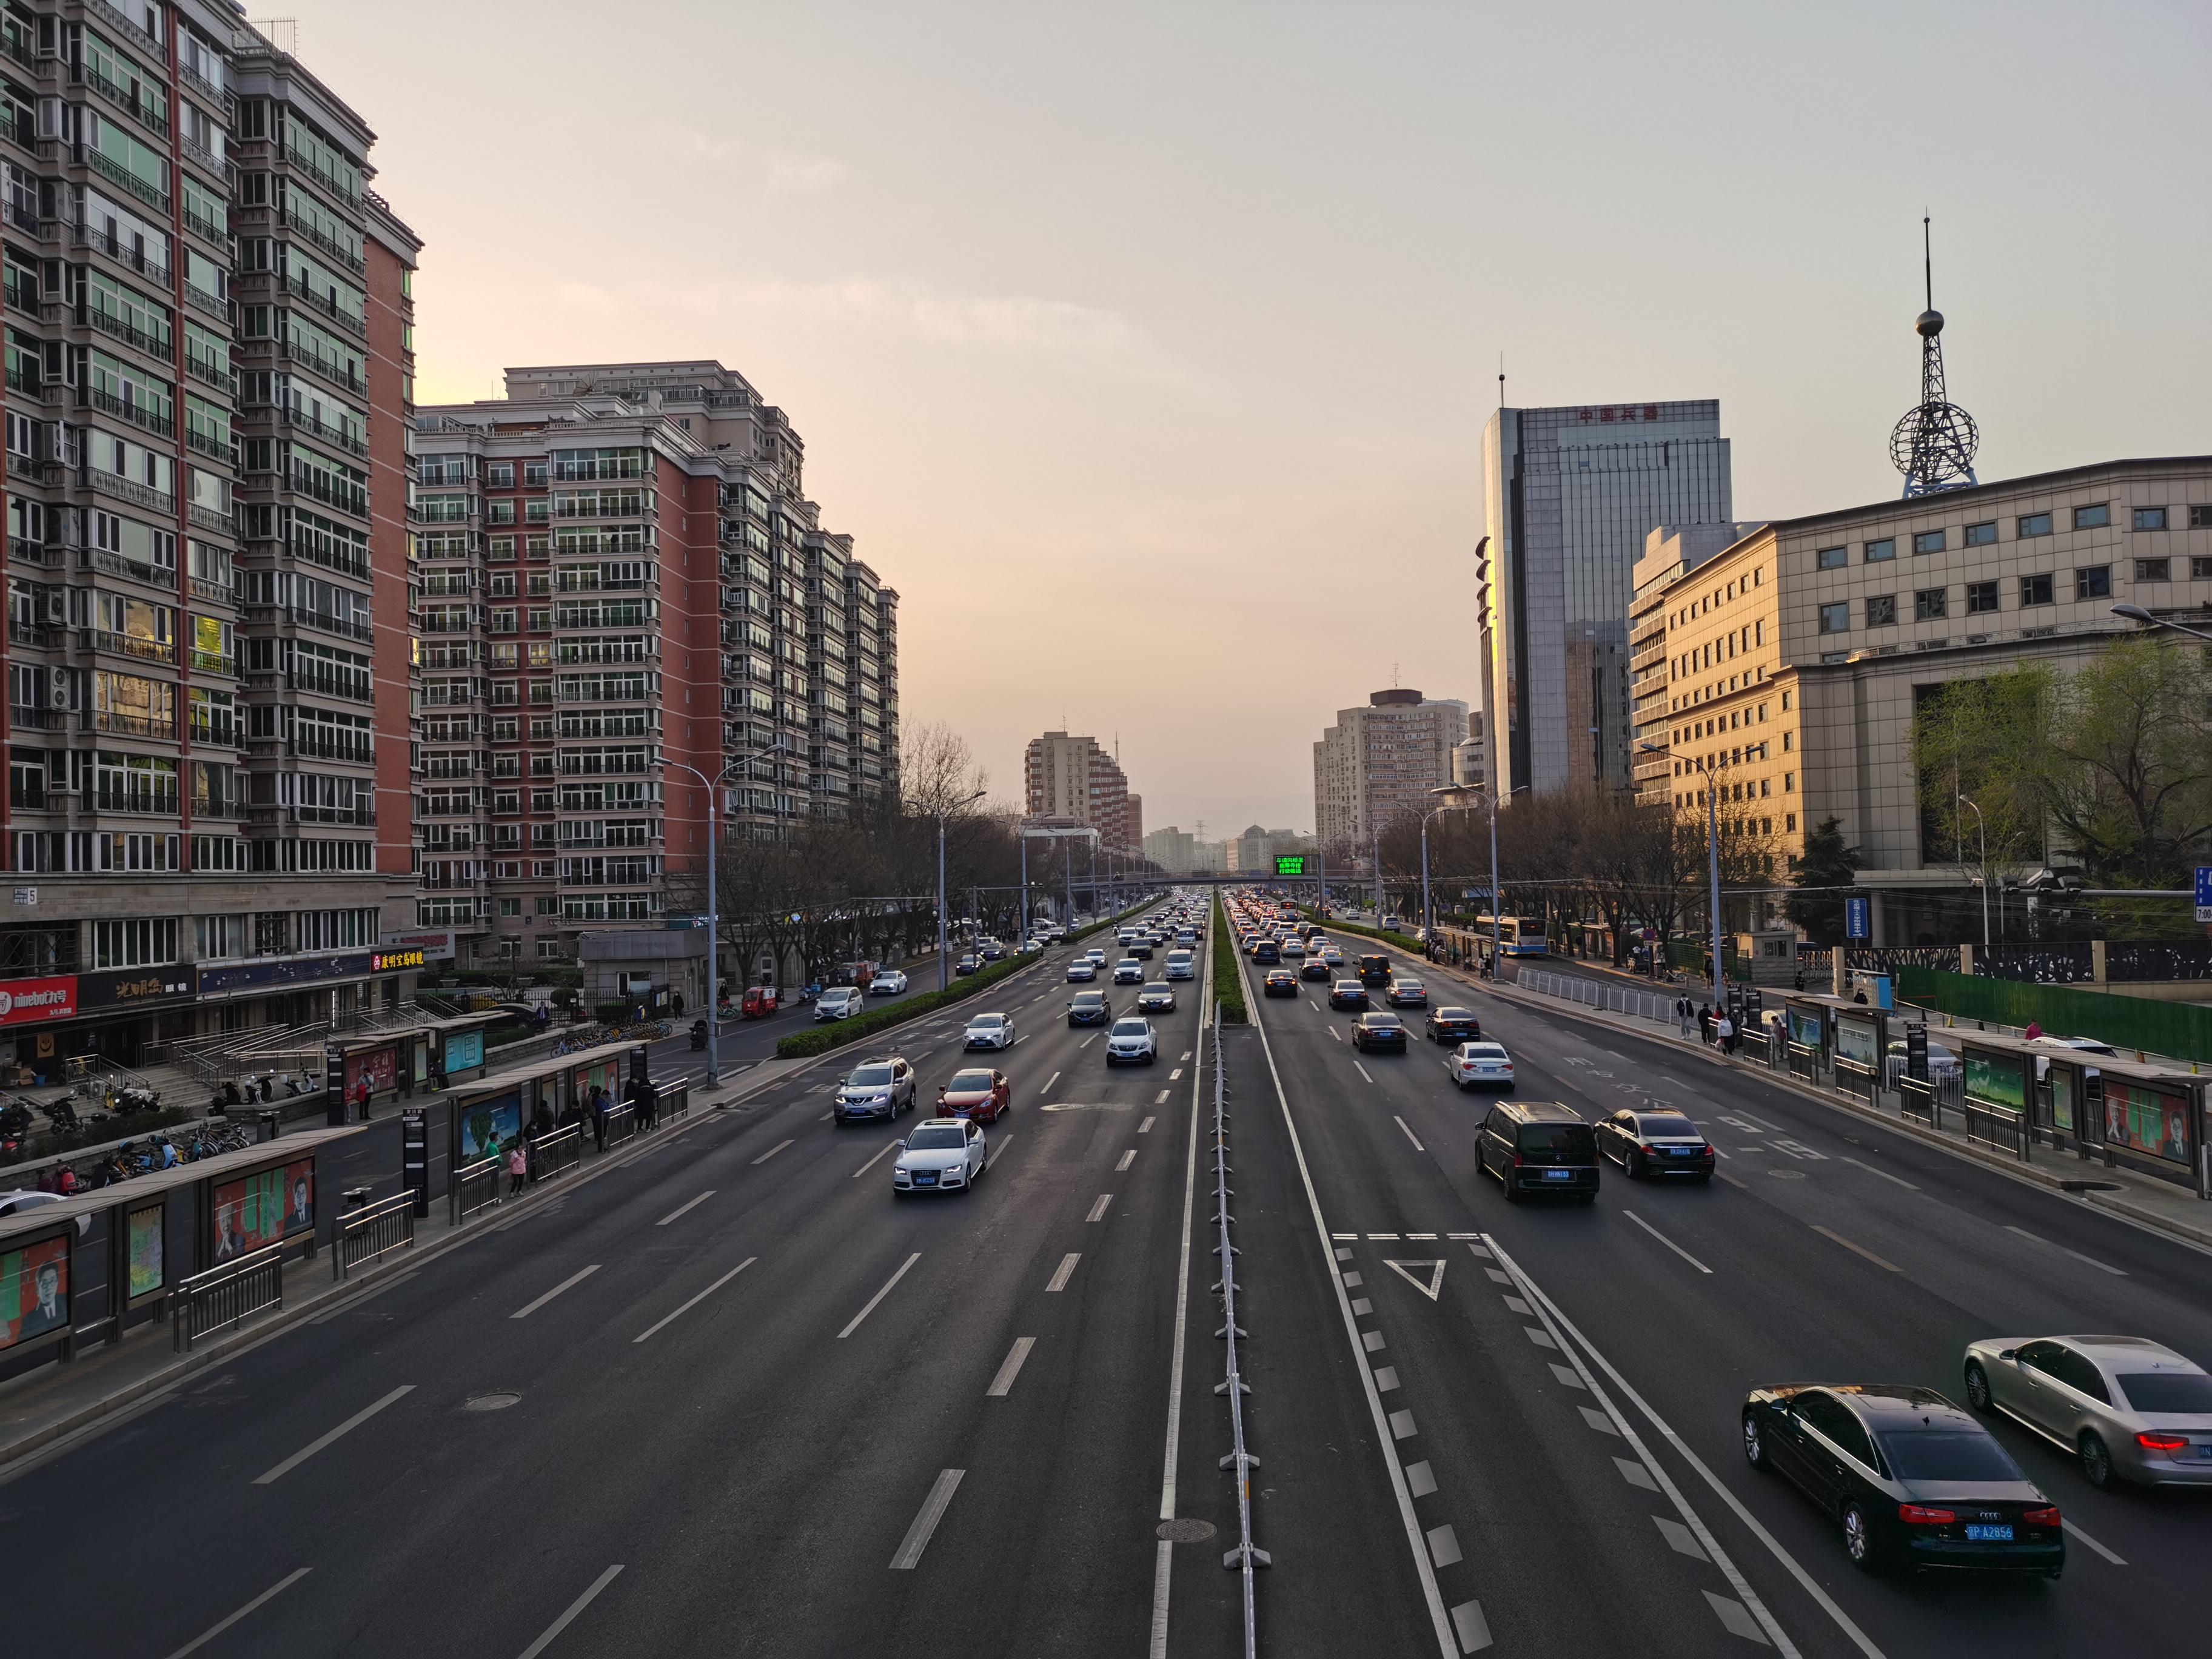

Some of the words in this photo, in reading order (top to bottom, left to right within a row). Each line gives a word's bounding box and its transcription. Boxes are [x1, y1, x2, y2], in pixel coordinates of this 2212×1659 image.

[1580, 406, 1658, 423] 中国兵器
[30, 890, 35, 902] 5
[381, 951, 423, 969] 康明宝岛眼镜
[165, 983, 187, 993] 眼镜
